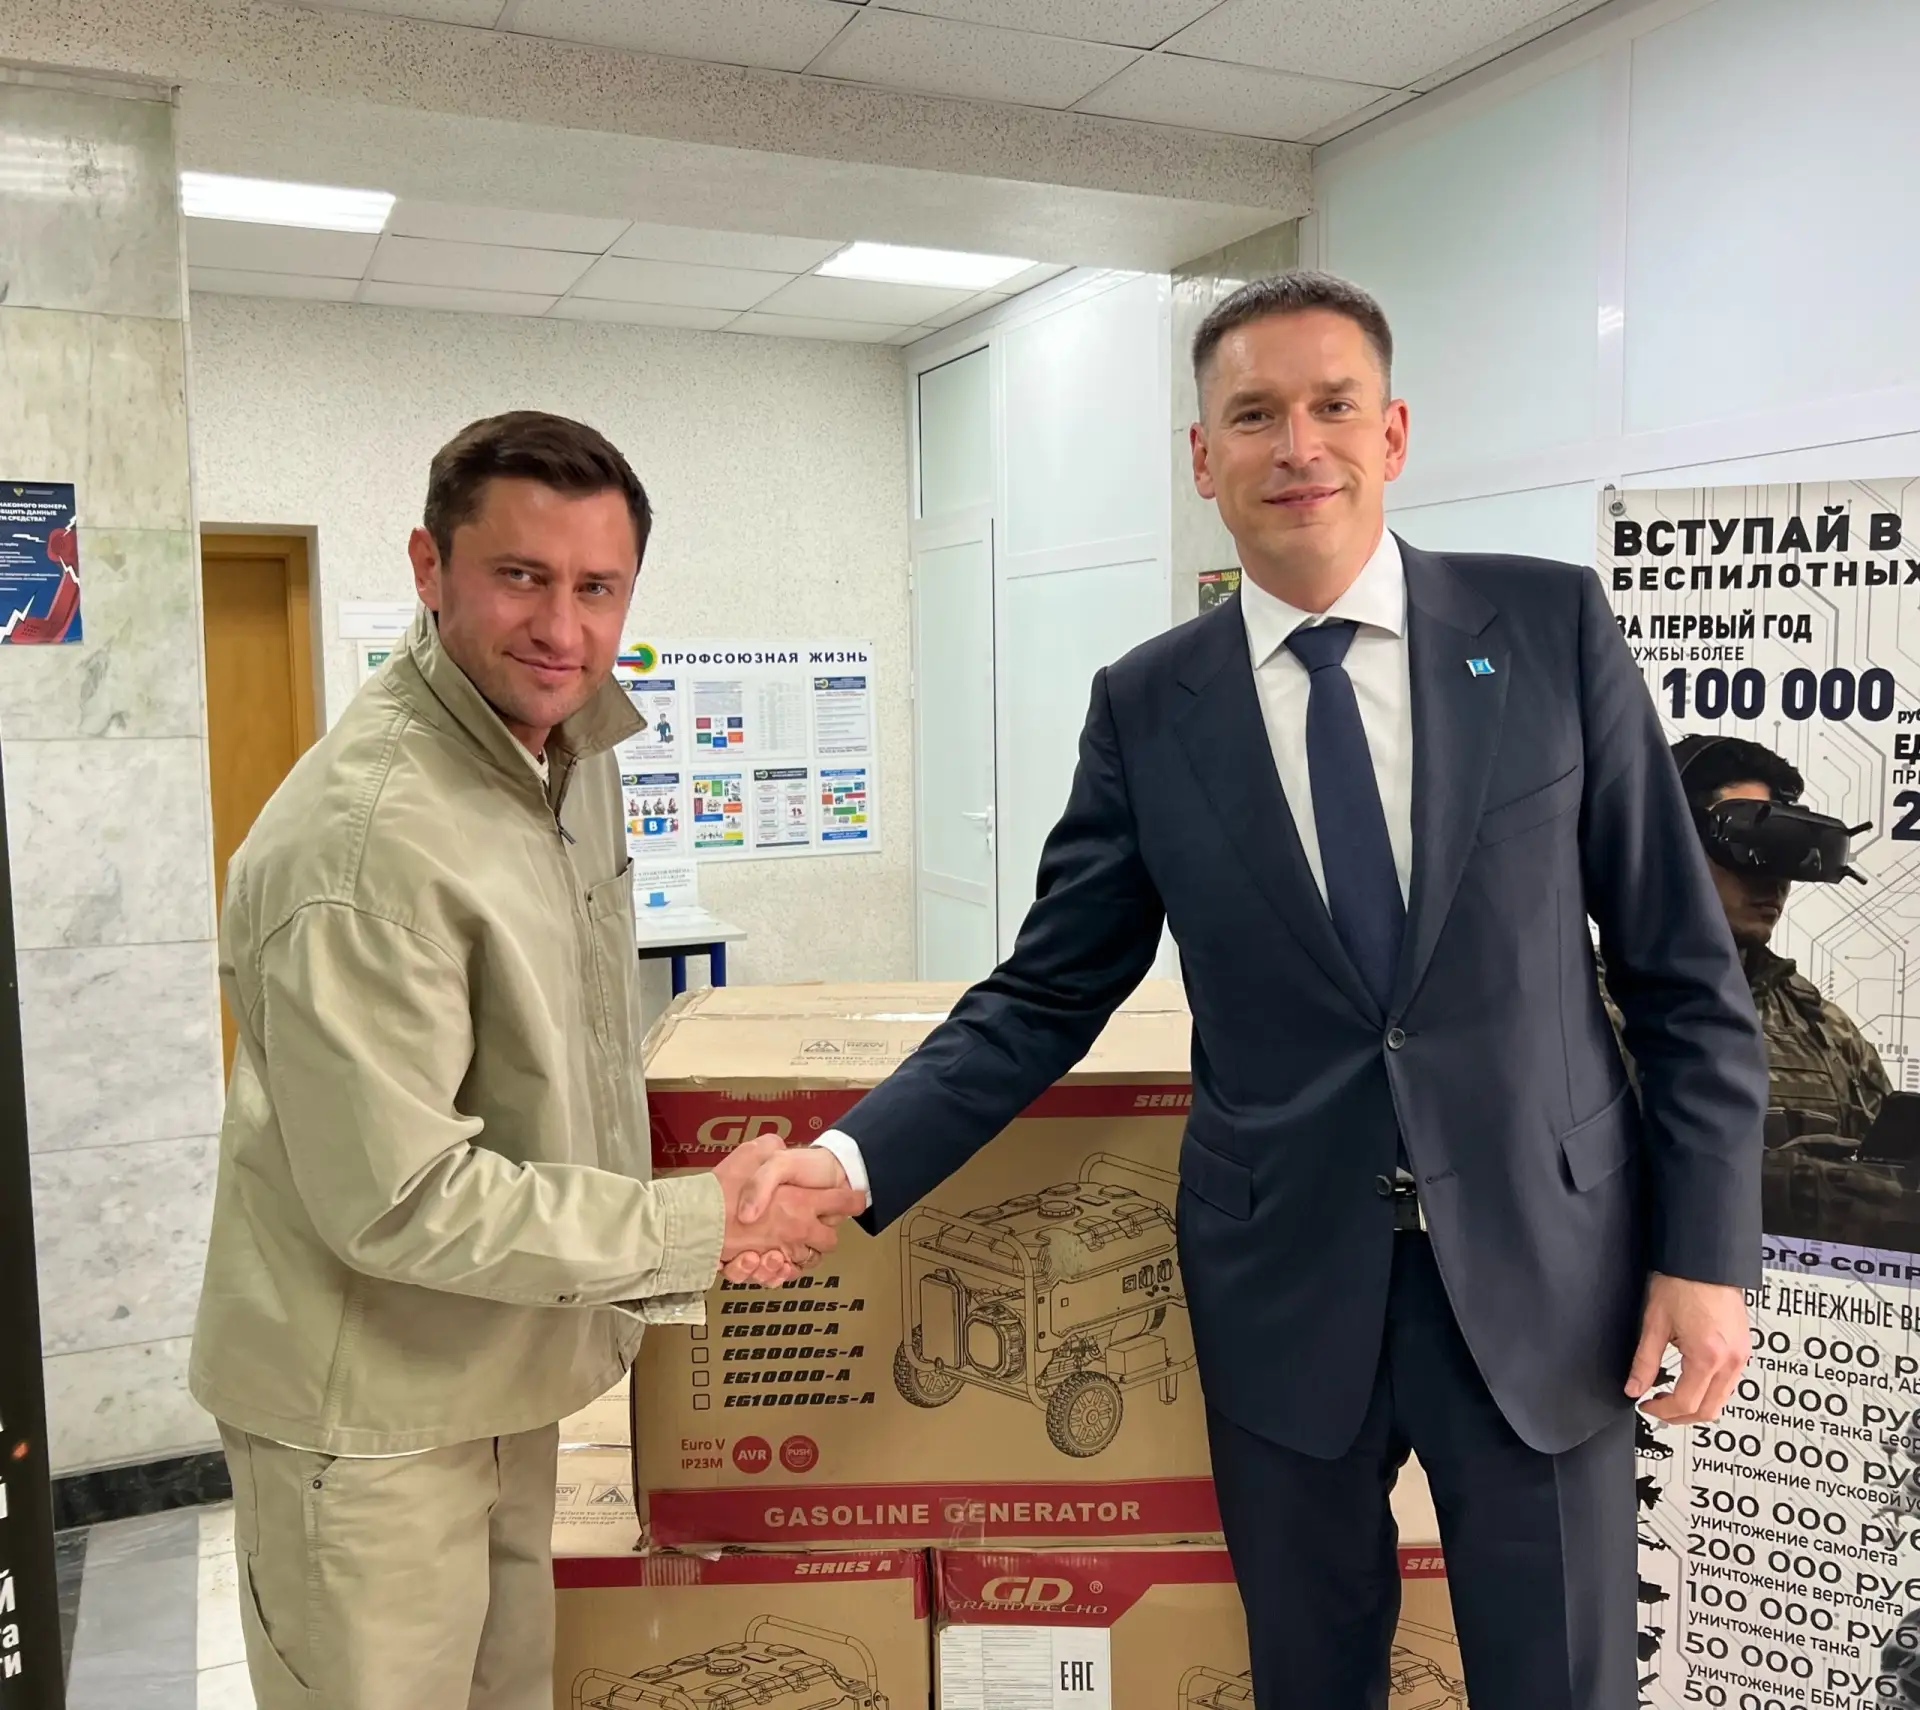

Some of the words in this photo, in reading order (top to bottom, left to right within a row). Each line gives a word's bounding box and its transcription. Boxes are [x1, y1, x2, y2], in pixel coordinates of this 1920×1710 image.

[1613, 506, 1850, 557] ВСТУПАЙ
[1869, 513, 1902, 551] В
[1612, 559, 1920, 591] БЕСПИЛОТНЫХ
[1650, 609, 1755, 640] ПЕРВЫЙ
[1763, 614, 1812, 643] ГОД
[661, 652, 799, 665] ПРОФСОЮЗНАЯ
[809, 651, 868, 664] ЖИЗНЬ
[1629, 646, 1684, 661] УЖБЫ
[1690, 646, 1744, 661] БОЛЕЕ
[1662, 667, 1766, 720] 100
[1781, 667, 1895, 722] 000
[721, 1299, 865, 1314] EG6500es-A
[1777, 1287, 1894, 1329] ДЕНЕЖНЫЕ
[721, 1322, 840, 1338] EG8000-A
[722, 1346, 865, 1361] EG8000es-A
[1803, 1336, 1881, 1369] 000
[723, 1368, 851, 1384] EG10000-A
[1757, 1356, 1809, 1377] танка
[1814, 1363, 1896, 1394] Leopard,
[723, 1391, 876, 1408] EG10000es-A
[1773, 1385, 1849, 1418] 000
[681, 1439, 712, 1451] Euro
[715, 1438, 726, 1450] V
[1819, 1420, 1874, 1443] танка
[681, 1457, 723, 1470] IP23M
[737, 1449, 767, 1461] AVR
[1692, 1425, 1762, 1458] 300
[1774, 1441, 1850, 1474] 000
[1692, 1457, 1811, 1489] уничтожение
[1815, 1479, 1901, 1507] пусковой
[764, 1504, 930, 1527] GASOLINE
[943, 1500, 1141, 1524] GENERATOR
[1689, 1485, 1760, 1518] 300
[1772, 1502, 1847, 1536] 000
[1691, 1513, 1808, 1548] уничтожение
[1813, 1538, 1898, 1567] самолета
[794, 1561, 871, 1576] SERIES
[876, 1560, 892, 1571] A
[1686, 1533, 1756, 1566] 200
[1768, 1550, 1842, 1585] 000
[981, 1576, 1074, 1606] GD
[1690, 1560, 1807, 1597] уничтожение
[1812, 1586, 1904, 1617] вертолета
[1685, 1580, 1748, 1613] 100
[1759, 1597, 1834, 1632] 000
[1689, 1610, 1806, 1646] уничтожение
[1810, 1636, 1860, 1659] танка
[1685, 1631, 1729, 1660] 50
[1741, 1644, 1814, 1679] 000
[1060, 1661, 1095, 1692] EAC
[1687, 1662, 1805, 1700] уничтожение
[1683, 1679, 1727, 1708] 50
